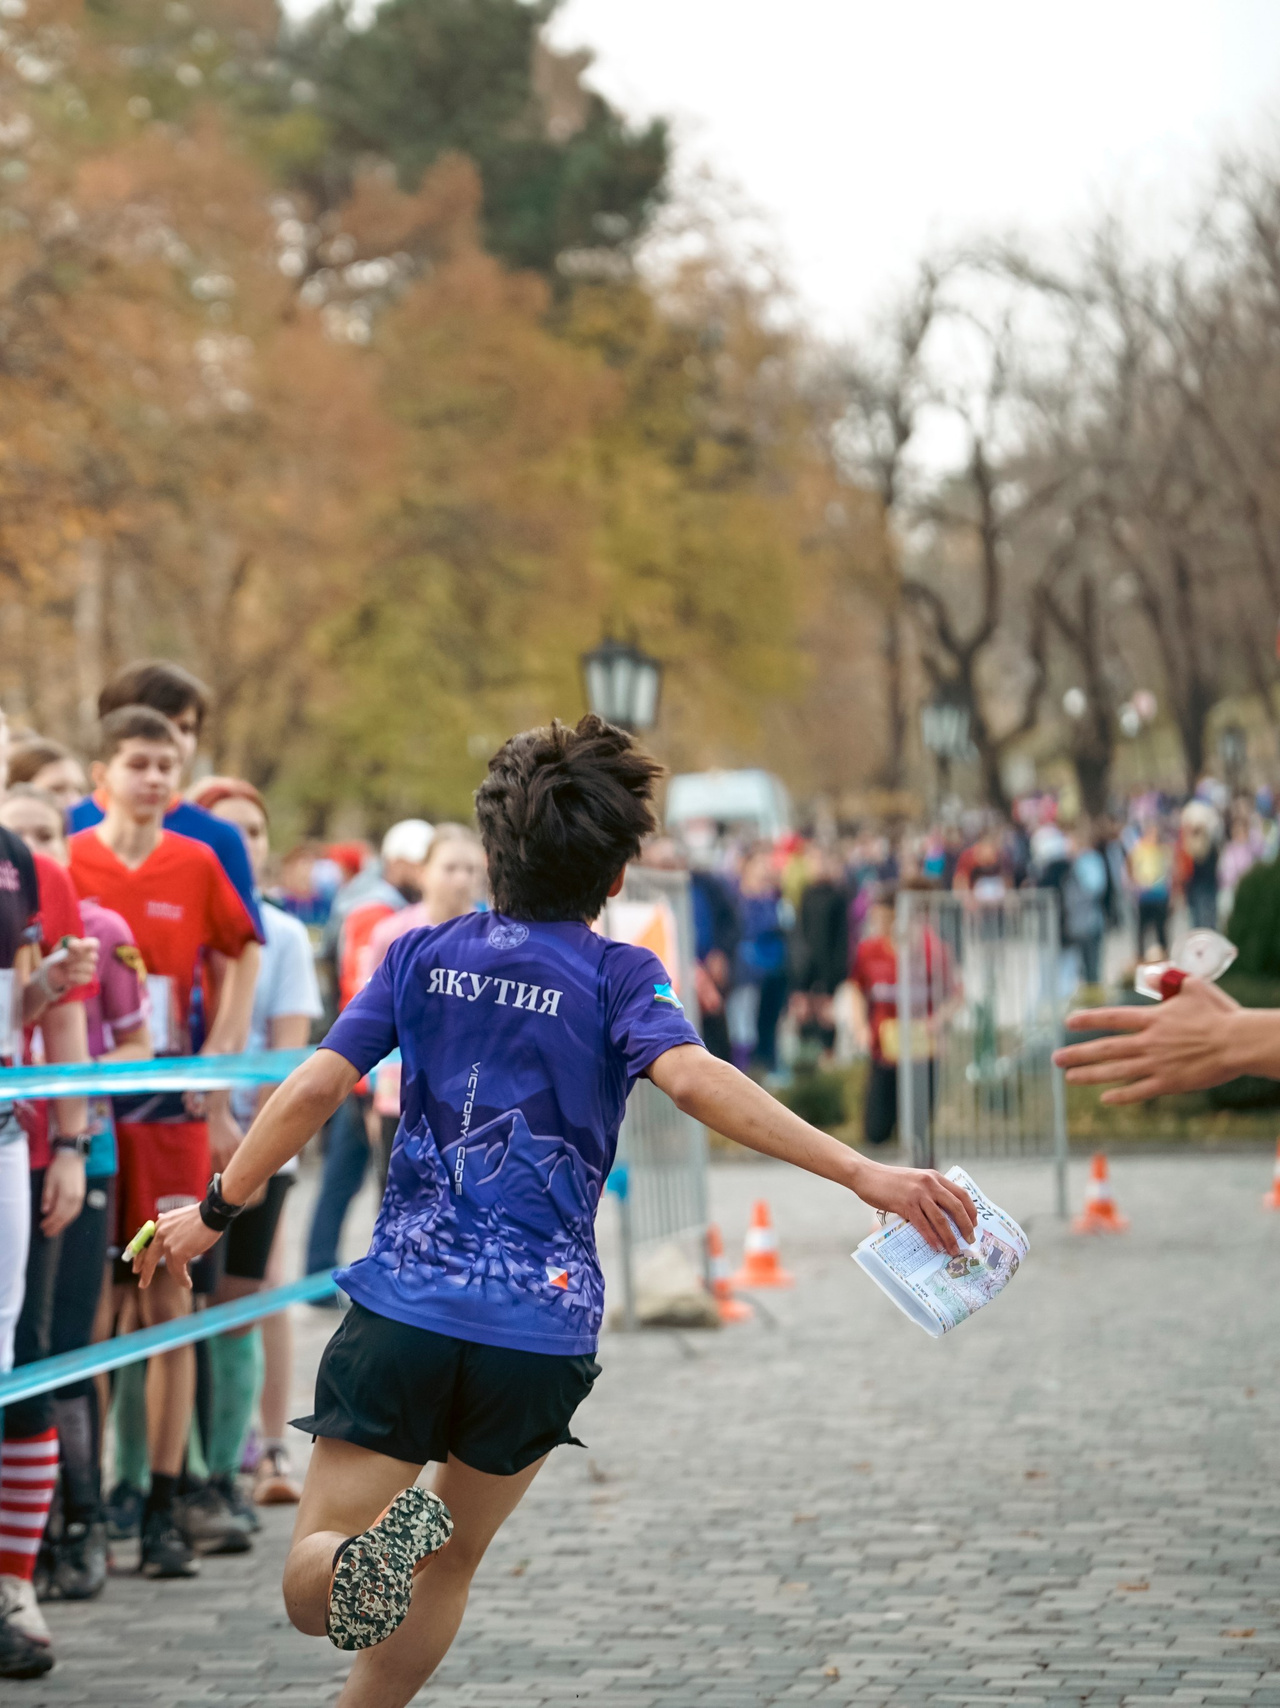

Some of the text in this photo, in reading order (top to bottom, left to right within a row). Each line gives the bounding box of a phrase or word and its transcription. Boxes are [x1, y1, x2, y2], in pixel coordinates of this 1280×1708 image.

[426, 967, 564, 1017] ЯКУТИЯ
[454, 1061, 481, 1196] VICTORY CODE
